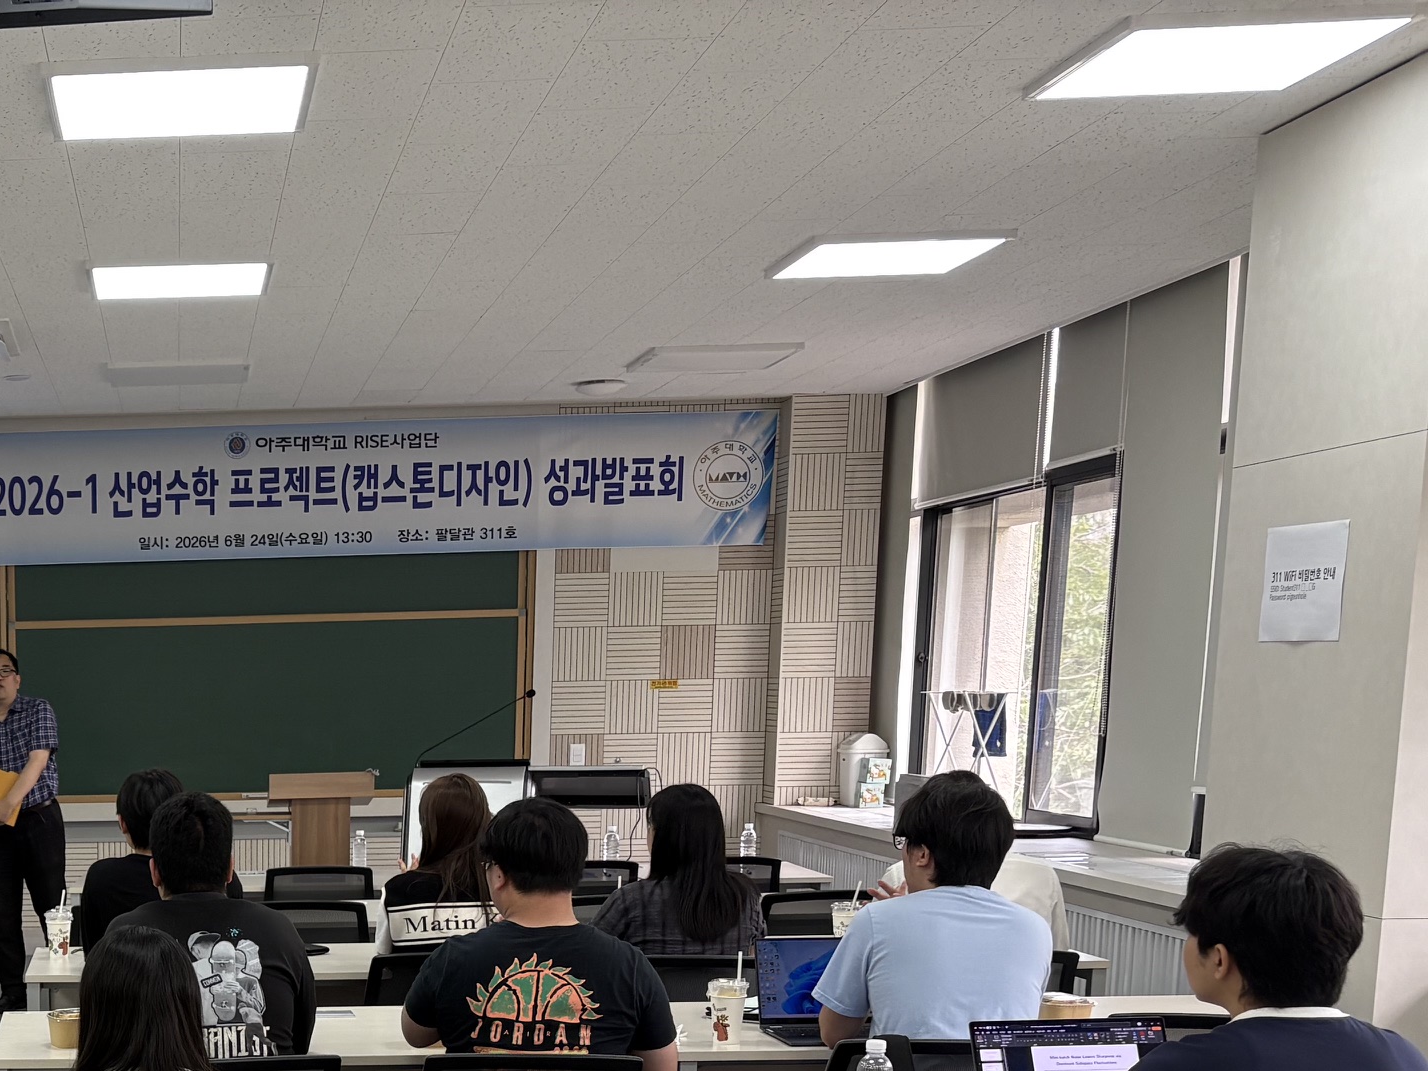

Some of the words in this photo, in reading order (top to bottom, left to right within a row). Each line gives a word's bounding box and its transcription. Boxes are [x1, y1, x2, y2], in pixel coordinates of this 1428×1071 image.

[255, 434, 347, 453] 아주대학교
[354, 432, 439, 449] RISE사업단
[700, 443, 757, 464] 아주대학교
[108, 465, 219, 518] 산업수학
[228, 457, 532, 514] 프로젝트(캡스톤디자인)
[544, 454, 684, 507] 성과발표회
[697, 483, 757, 508] MATHEMATICS
[138, 536, 170, 550] 일시:
[175, 534, 219, 549] 2026년
[224, 533, 246, 548] 6월
[250, 531, 329, 548] 24일(수요일)
[334, 530, 372, 544] 13:30
[397, 528, 429, 543] 장소:
[435, 527, 476, 541] 팔달관
[479, 525, 518, 540] 311호
[1271, 572, 1282, 583] 311
[1284, 569, 1297, 582] WiFi
[1298, 567, 1322, 582] 비밀번호
[1323, 566, 1336, 580] 안내
[403, 914, 477, 934] Matin
[470, 1018, 592, 1046] JORDAN
